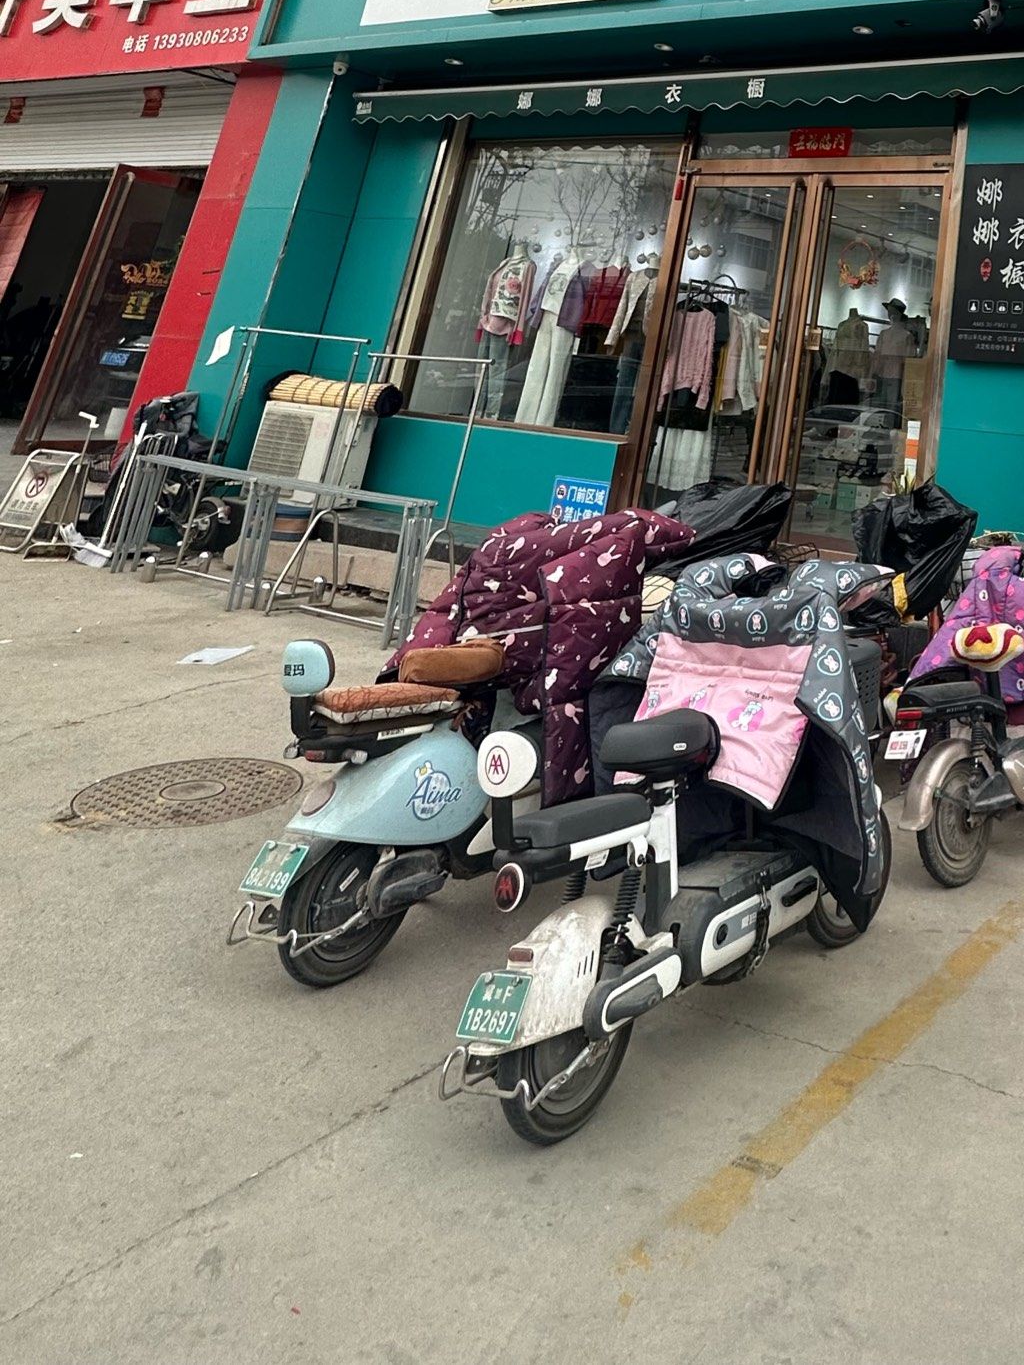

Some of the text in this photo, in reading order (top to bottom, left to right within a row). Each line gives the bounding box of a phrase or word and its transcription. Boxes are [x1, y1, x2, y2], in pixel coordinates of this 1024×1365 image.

[122, 25, 249, 53] 电话 13930806233
[516, 77, 766, 111] 娜娜衣橱
[972, 177, 1003, 253] 娜娜
[566, 485, 606, 506] 门前区域
[405, 776, 462, 807] Aima
[464, 1007, 517, 1035] 1B2697
